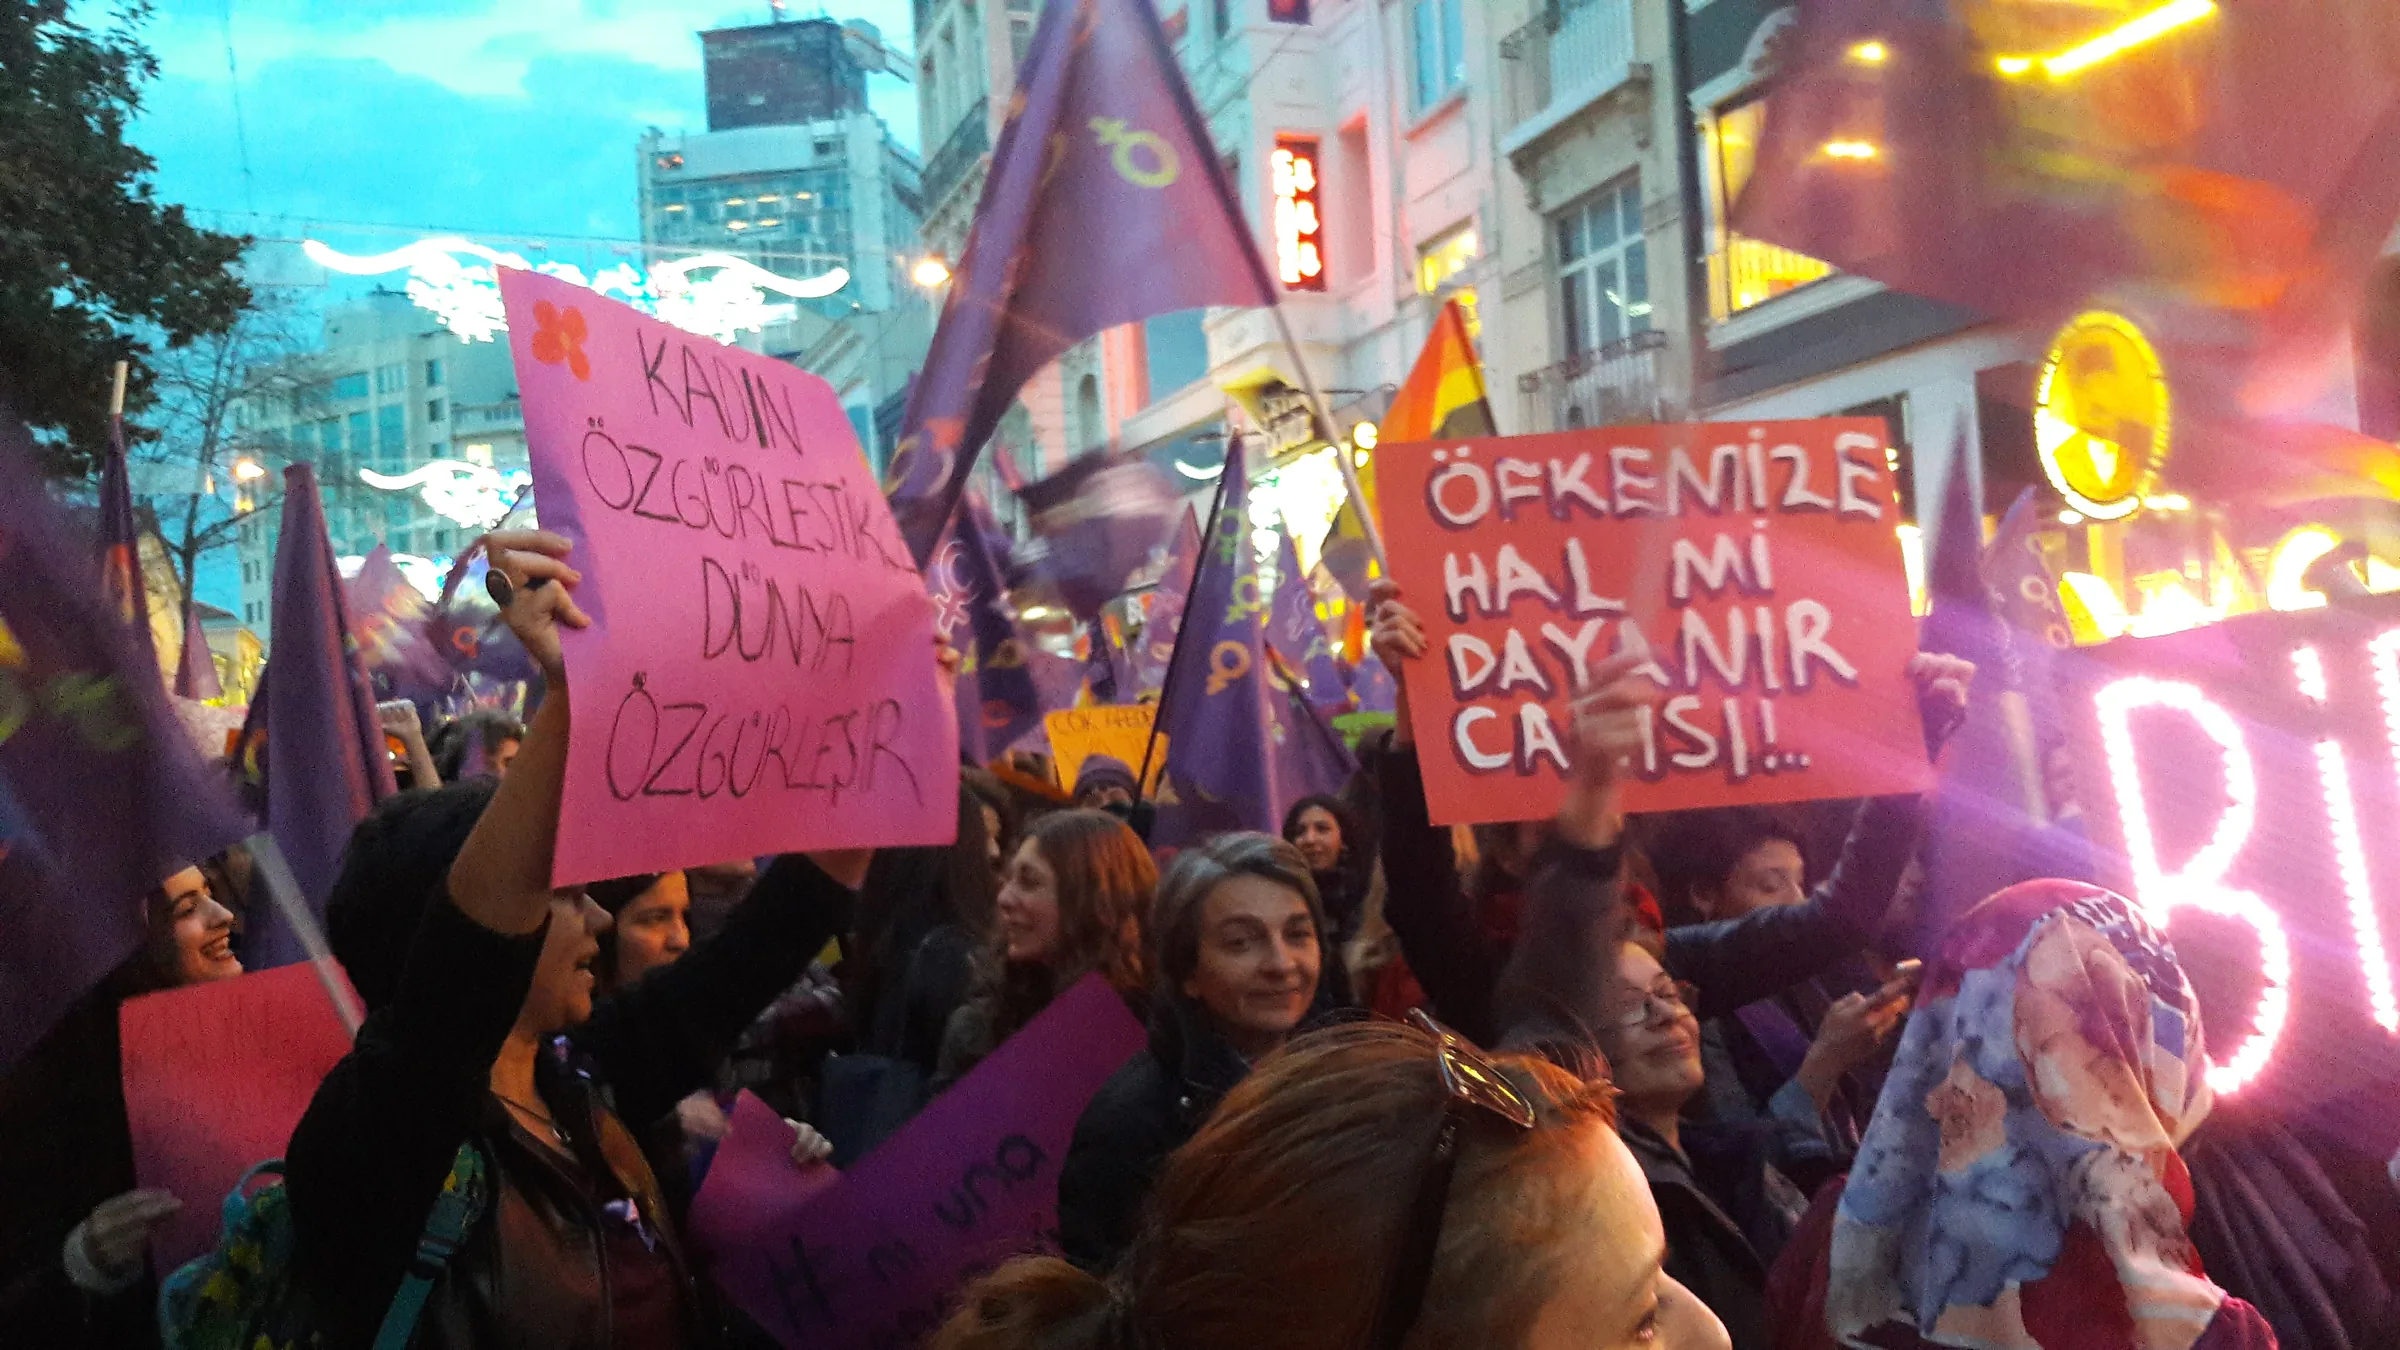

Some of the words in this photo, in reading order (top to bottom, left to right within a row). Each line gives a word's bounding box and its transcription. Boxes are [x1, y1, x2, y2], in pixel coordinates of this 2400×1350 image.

[636, 328, 804, 457] KADIN
[1429, 427, 1882, 527] ÖFKEMİZE
[701, 557, 856, 674] DÜNYA
[1444, 536, 1627, 616] HAL
[1448, 598, 1858, 693] DAYANIR
